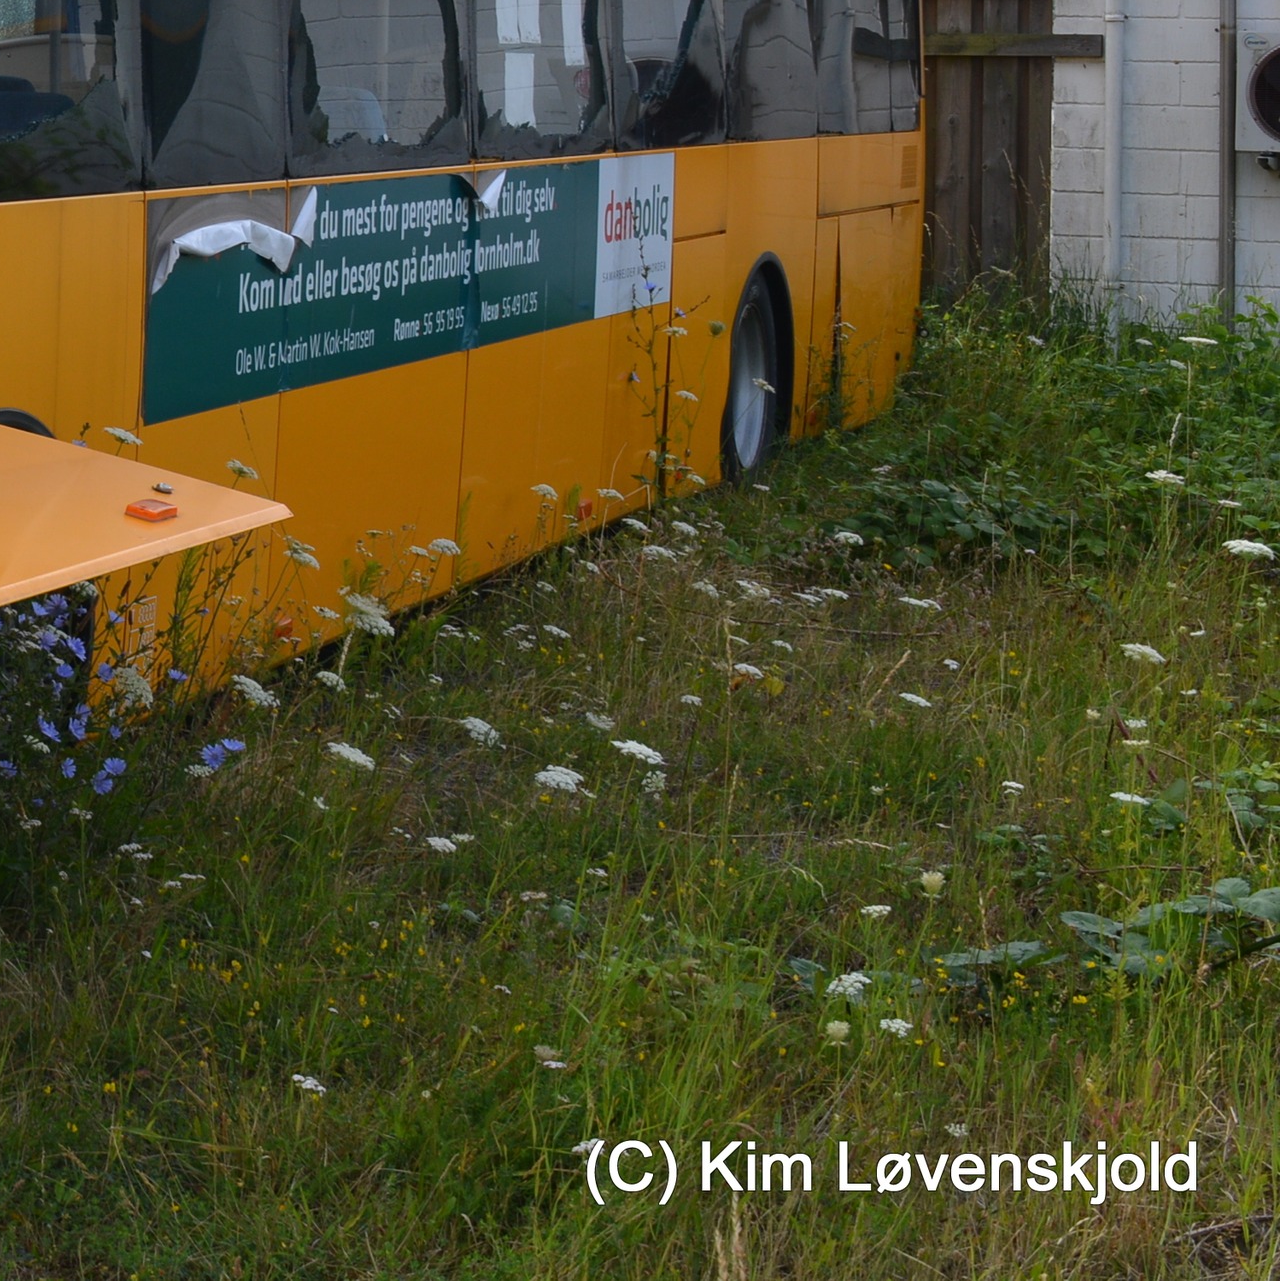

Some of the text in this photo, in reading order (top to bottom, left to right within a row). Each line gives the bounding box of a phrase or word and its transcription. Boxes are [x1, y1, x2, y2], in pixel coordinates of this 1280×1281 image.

[320, 200, 338, 240] du
[342, 199, 377, 237] mest
[379, 194, 399, 232] for
[401, 197, 453, 240] pengene
[455, 197, 469, 232] og
[502, 182, 514, 217] til
[515, 180, 532, 223] dig
[605, 184, 669, 243] danbolig
[239, 272, 274, 314] Kom
[306, 260, 338, 302] eller
[341, 257, 381, 300] besøg
[384, 259, 399, 288] os
[401, 246, 417, 296] på
[235, 348, 252, 375] Ole
[254, 345, 266, 371] W.
[268, 342, 277, 368] &
[310, 333, 321, 358] W.
[323, 327, 375, 356] Kok-Hansen
